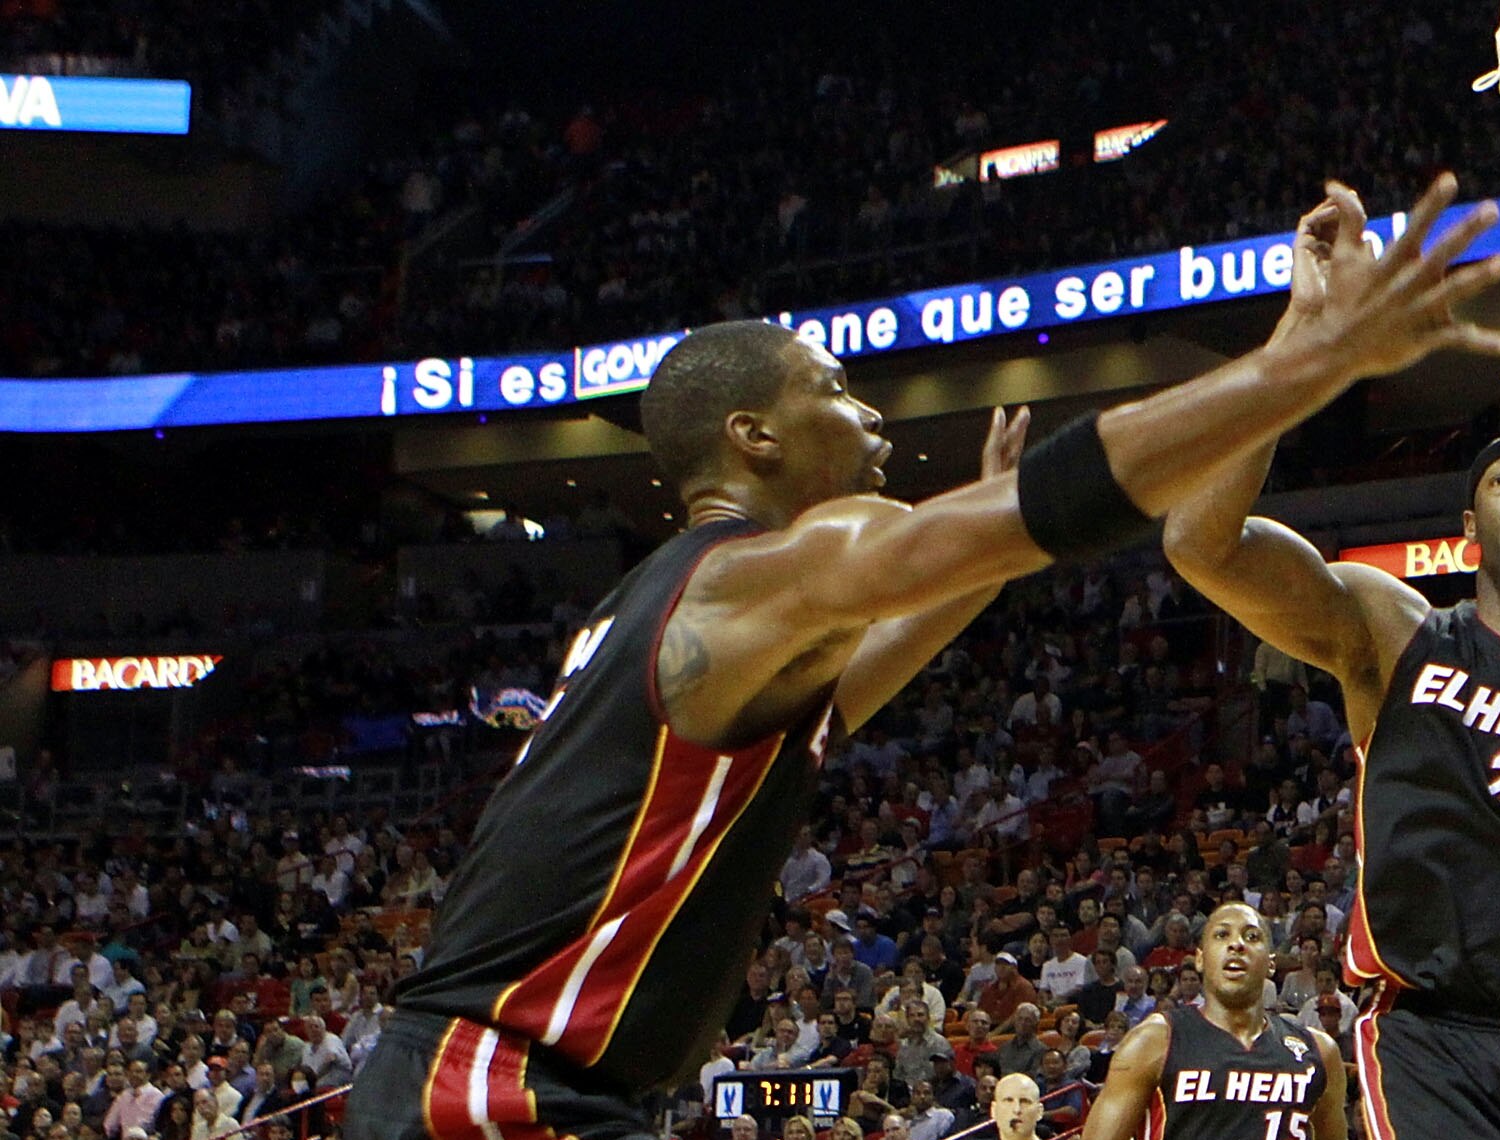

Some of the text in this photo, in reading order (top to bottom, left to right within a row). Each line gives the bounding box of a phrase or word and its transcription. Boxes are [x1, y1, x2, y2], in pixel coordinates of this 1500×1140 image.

[500, 362, 567, 404] es
[921, 286, 1031, 343] que
[1054, 264, 1155, 320] ser
[1411, 664, 1470, 713] EL
[760, 1081, 813, 1106] 7:11
[1174, 1066, 1316, 1103] EL HEAT
